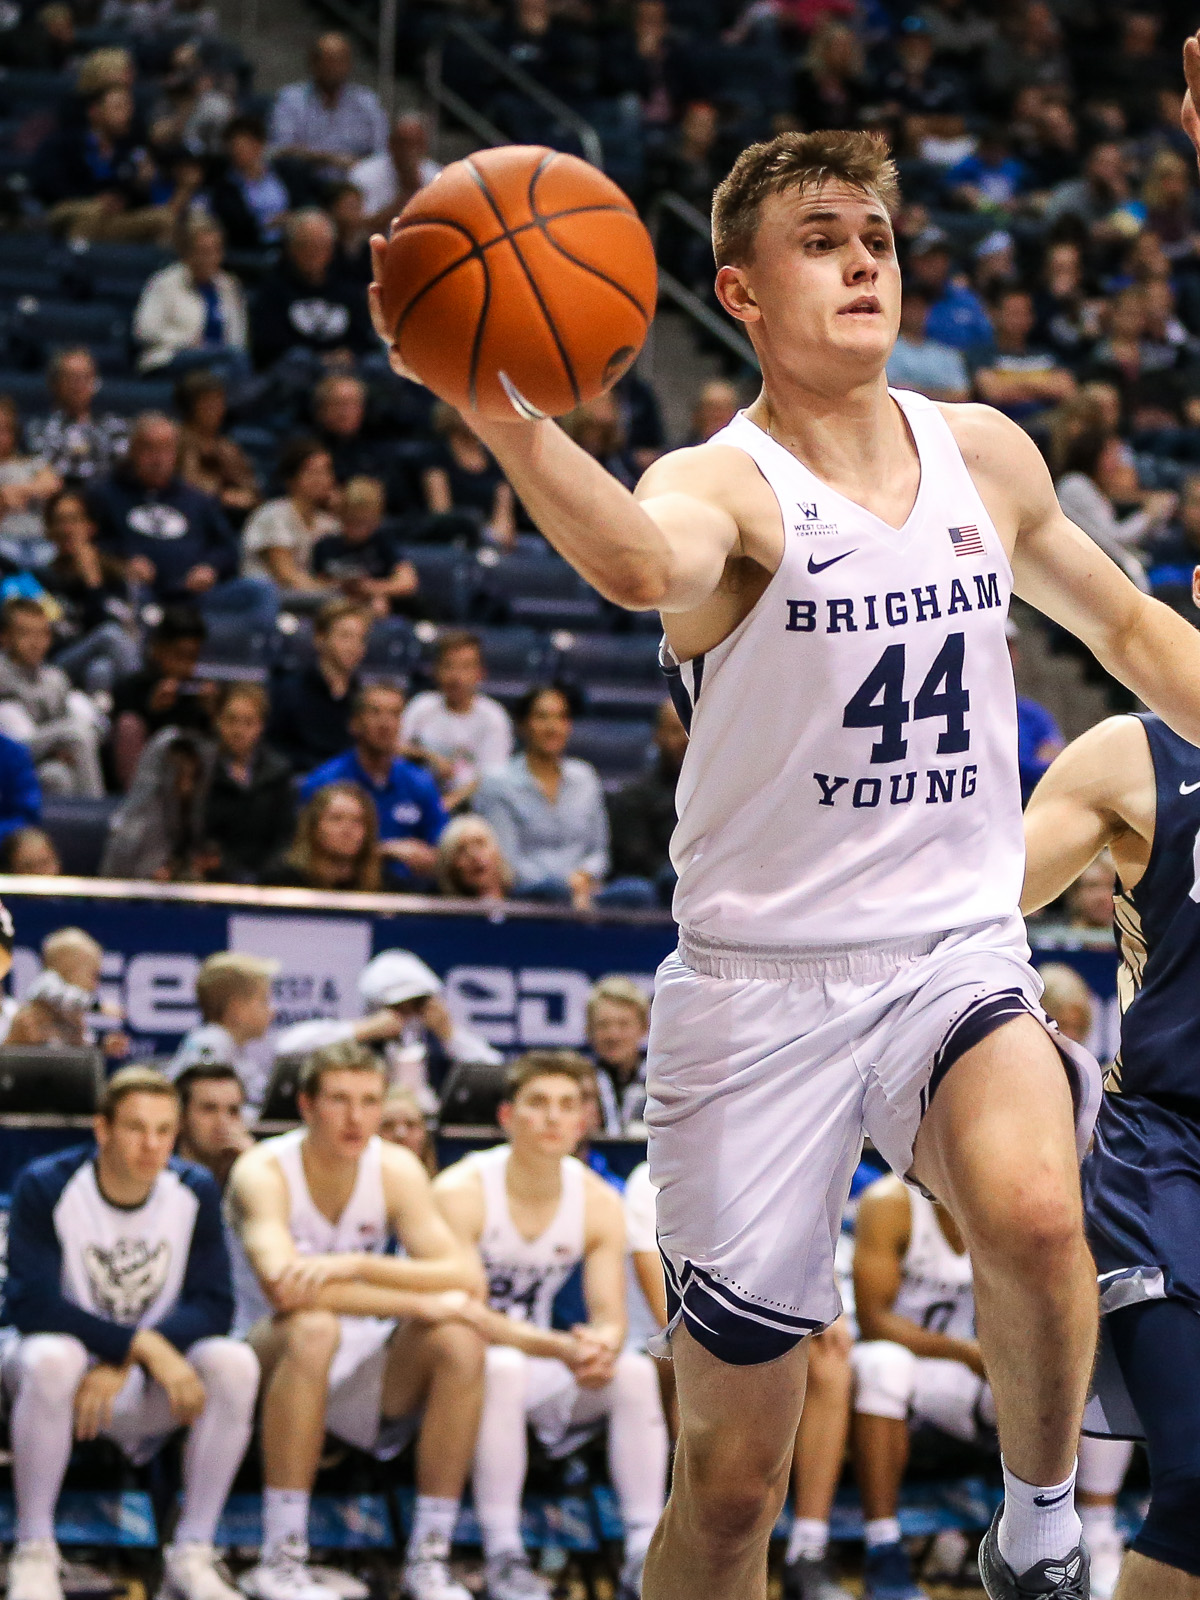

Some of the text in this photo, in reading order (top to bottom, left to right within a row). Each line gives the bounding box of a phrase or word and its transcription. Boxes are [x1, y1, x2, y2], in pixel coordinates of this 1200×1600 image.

[785, 572, 1002, 634] BRIGHAM
[842, 631, 970, 764] 44
[813, 764, 978, 809] YOUNG
